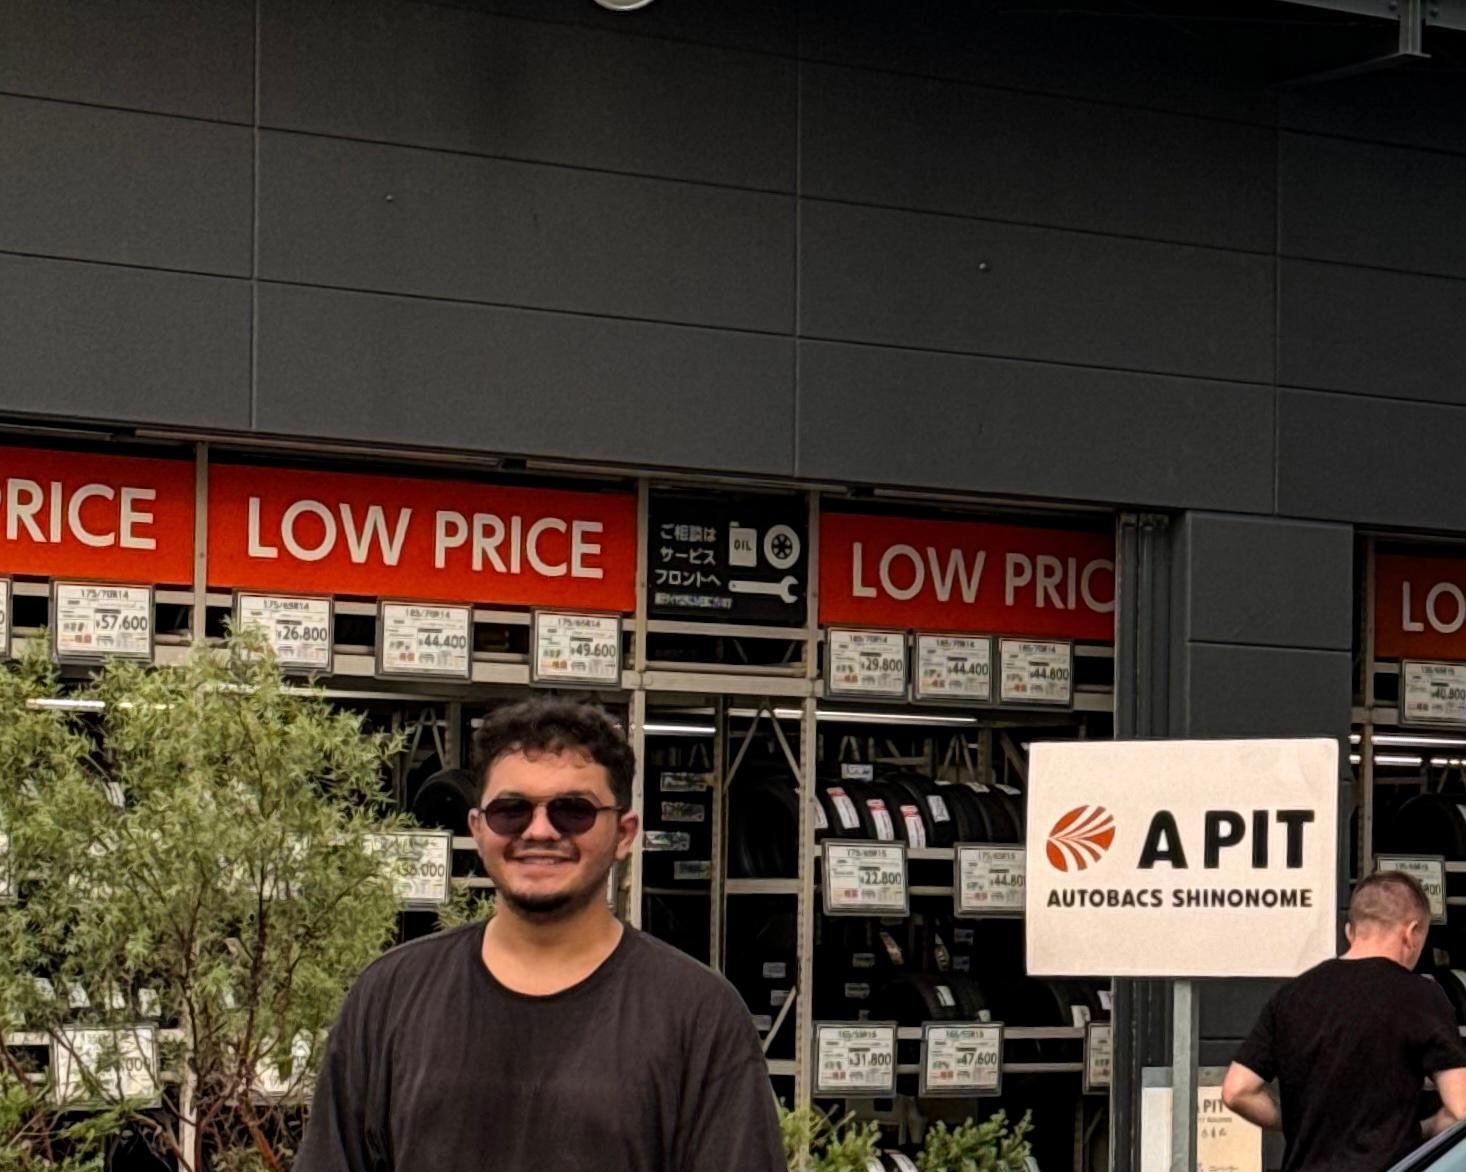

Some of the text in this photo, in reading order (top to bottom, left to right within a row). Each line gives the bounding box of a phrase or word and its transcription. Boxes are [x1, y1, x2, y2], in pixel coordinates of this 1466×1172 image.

[0, 478, 157, 550] RICE
[247, 496, 604, 579] LOW PRICE
[660, 523, 717, 543] ご相談は
[733, 539, 753, 551] OIL
[660, 546, 717, 566] サービス
[654, 569, 722, 588] フロントへ
[852, 541, 1115, 613] LOW PRIC
[1136, 809, 1315, 869] A PIT
[1046, 888, 1312, 908] AUTOBACS SHINONOME
